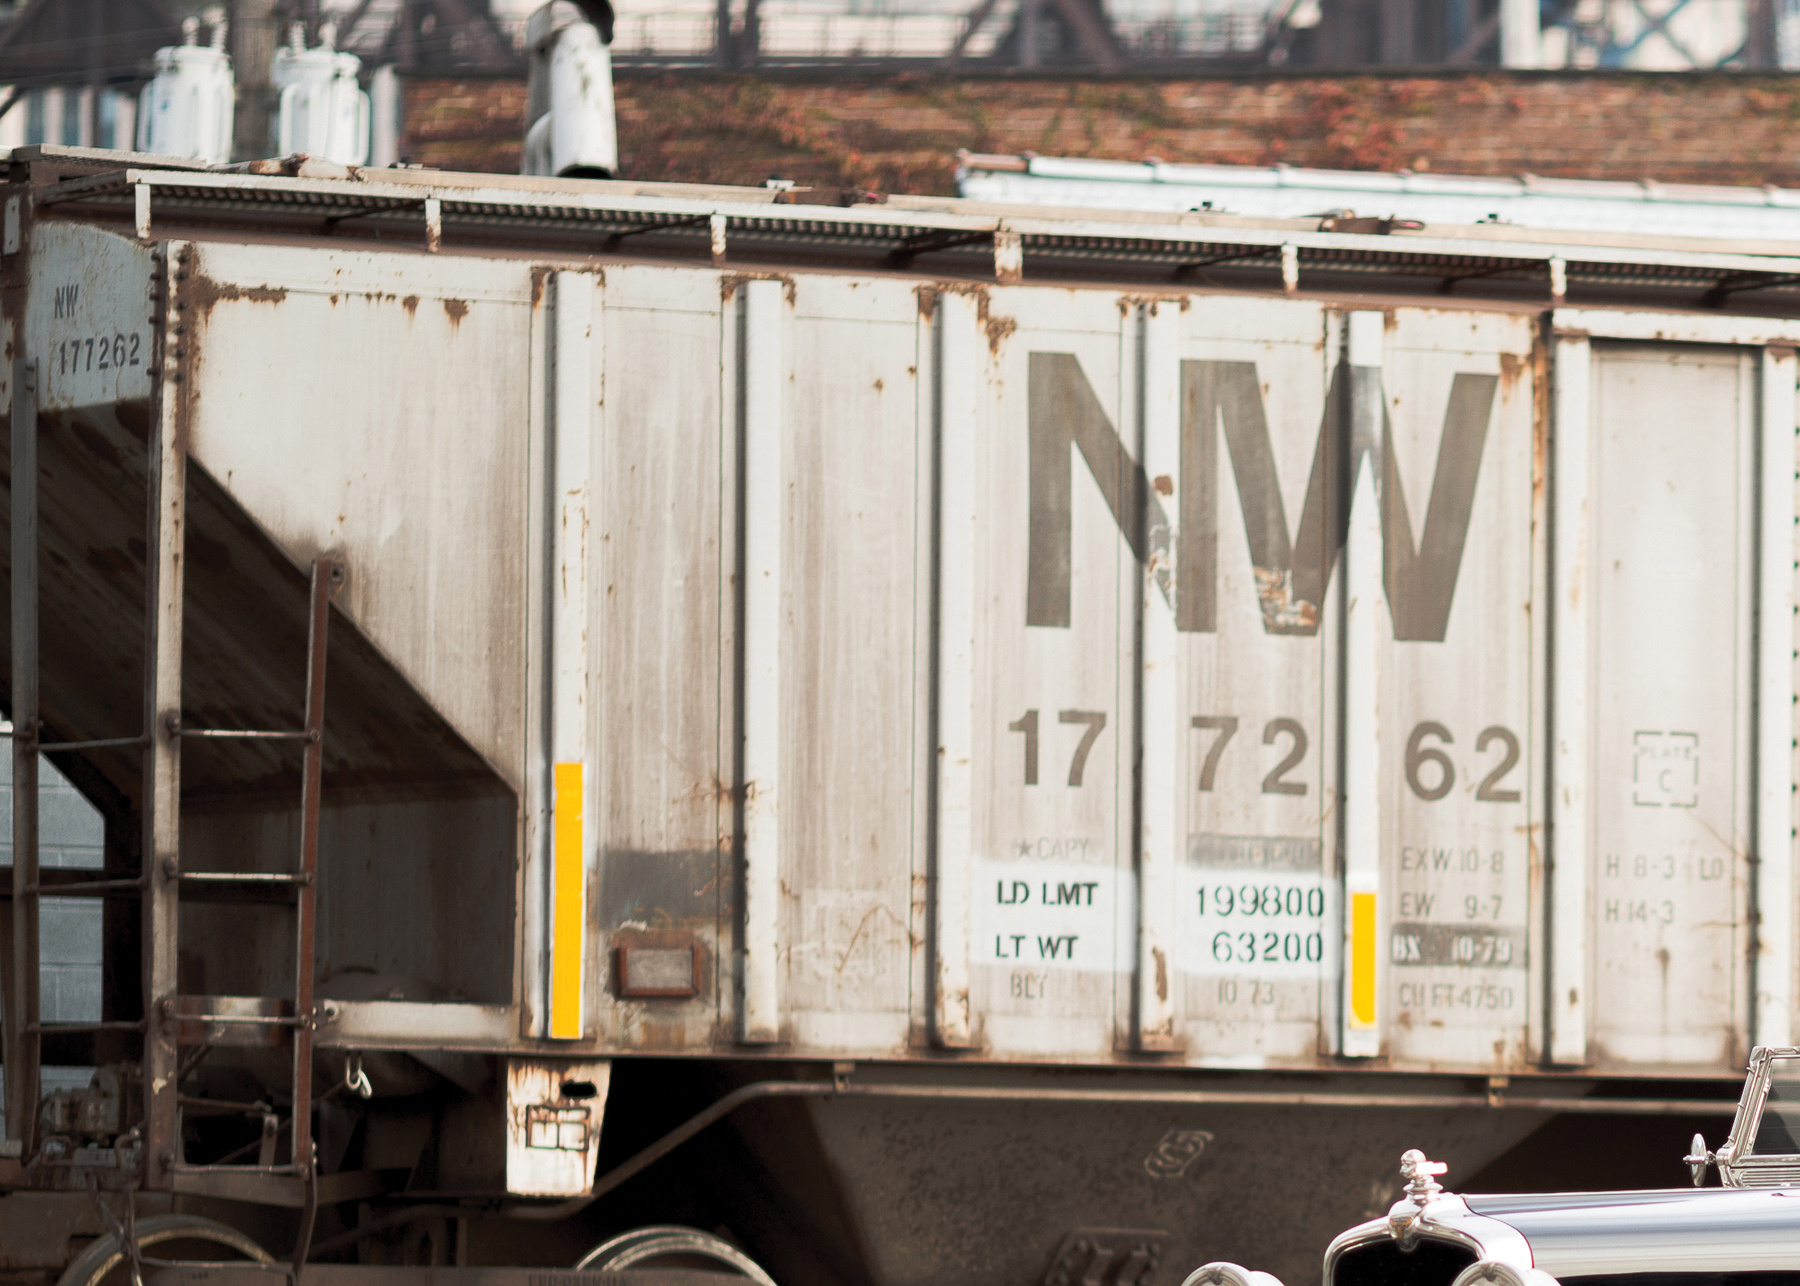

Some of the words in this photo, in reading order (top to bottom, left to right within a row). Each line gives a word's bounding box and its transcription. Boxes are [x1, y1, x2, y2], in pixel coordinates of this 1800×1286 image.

[54, 284, 79, 319] NW
[59, 332, 140, 375] 177262
[1026, 351, 1500, 643] NW
[1659, 769, 1672, 792] C
[1036, 836, 1090, 861] CAPY
[1606, 854, 1619, 878] H
[998, 880, 1030, 904] LD
[1042, 882, 1099, 906] LMT
[1197, 884, 1325, 918] 199800
[1400, 891, 1435, 917] EW
[1605, 899, 1619, 922] H
[996, 934, 1026, 958] LT
[1037, 935, 1079, 960] WT
[1212, 931, 1323, 963] 63200
[1400, 982, 1425, 1008] CU
